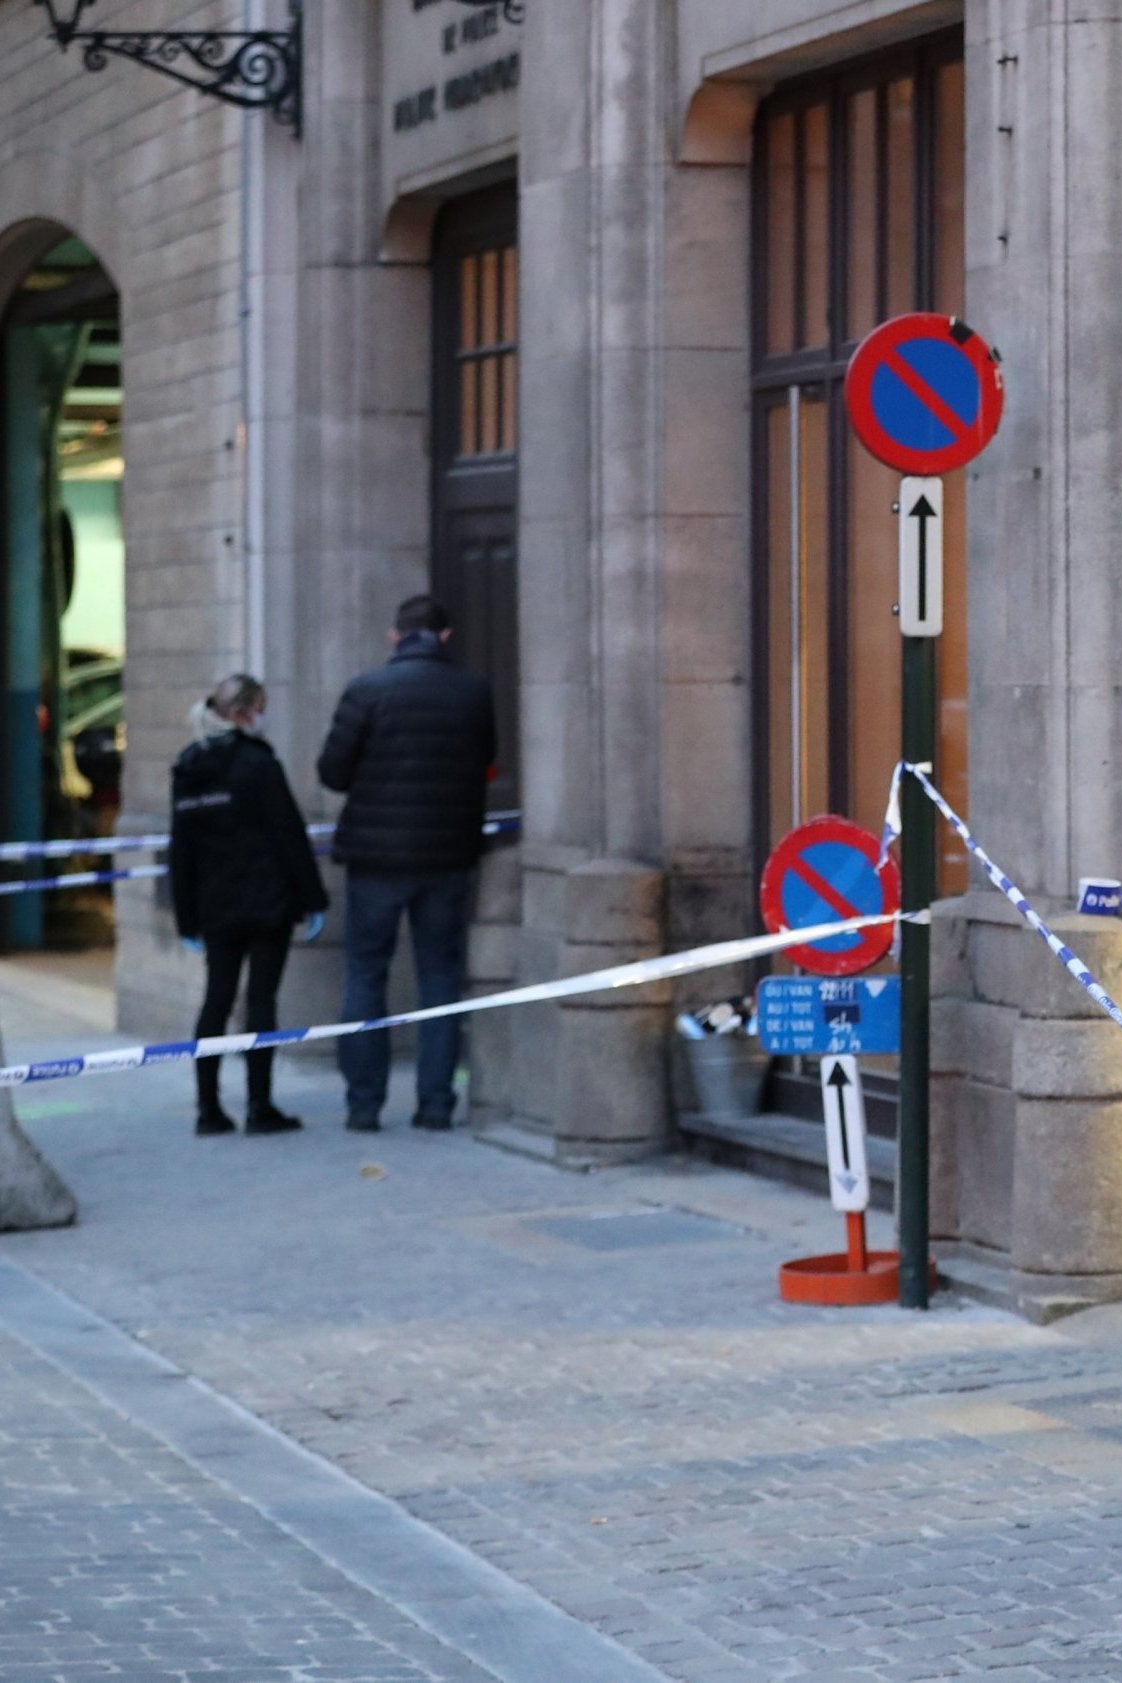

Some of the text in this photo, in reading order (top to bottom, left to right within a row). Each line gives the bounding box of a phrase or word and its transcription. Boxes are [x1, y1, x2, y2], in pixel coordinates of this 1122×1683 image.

[791, 1001, 812, 1015] TOT
[791, 1019, 815, 1032] VAN
[793, 1036, 814, 1049] TOT
